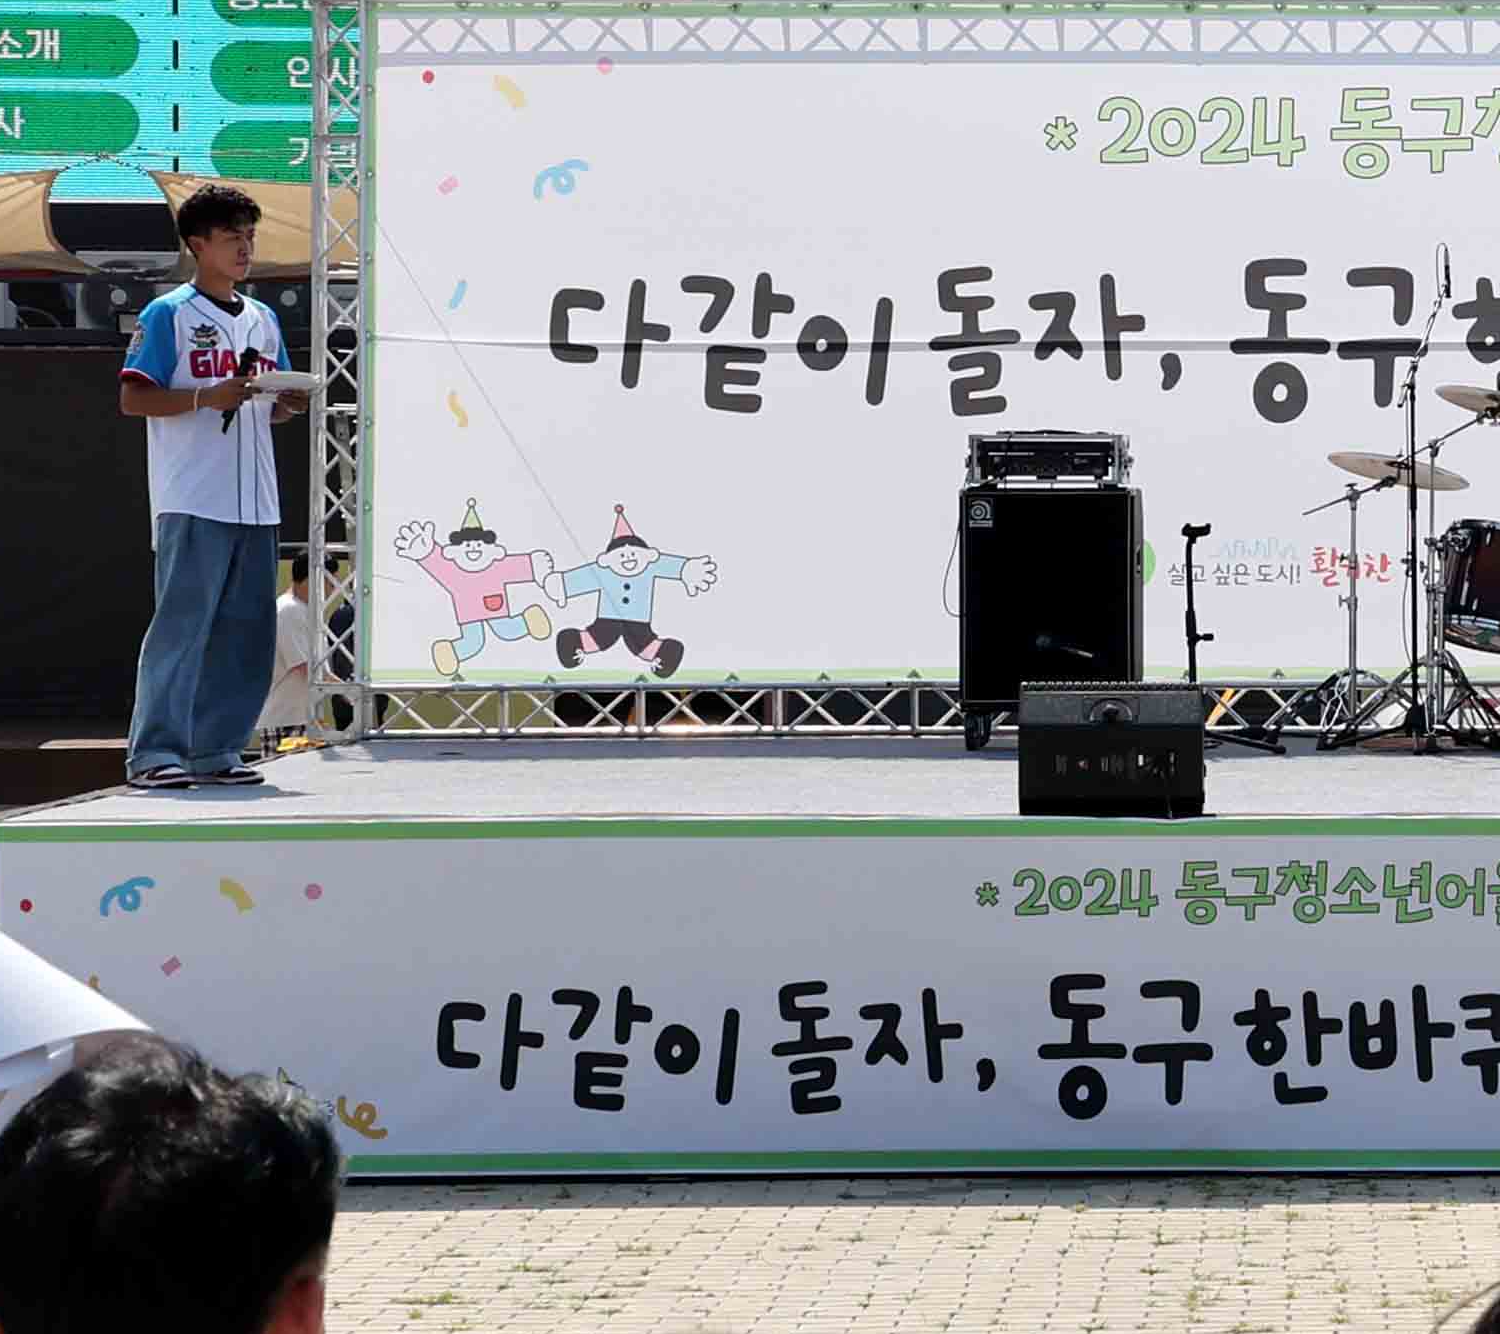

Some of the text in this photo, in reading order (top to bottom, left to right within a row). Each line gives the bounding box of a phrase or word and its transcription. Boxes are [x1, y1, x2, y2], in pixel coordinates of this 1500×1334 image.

[1097, 96, 1306, 166] 2024
[548, 271, 895, 415] 다같이
[928, 265, 1184, 417] 돌자,
[1229, 258, 1431, 425] 동구
[1212, 563, 1252, 586] 싶은
[1256, 564, 1301, 586] 도시!
[1011, 867, 1159, 917] 2024
[436, 985, 740, 1112] 다같이
[771, 979, 997, 1116] 돌자,
[1037, 972, 1213, 1121] 동구
